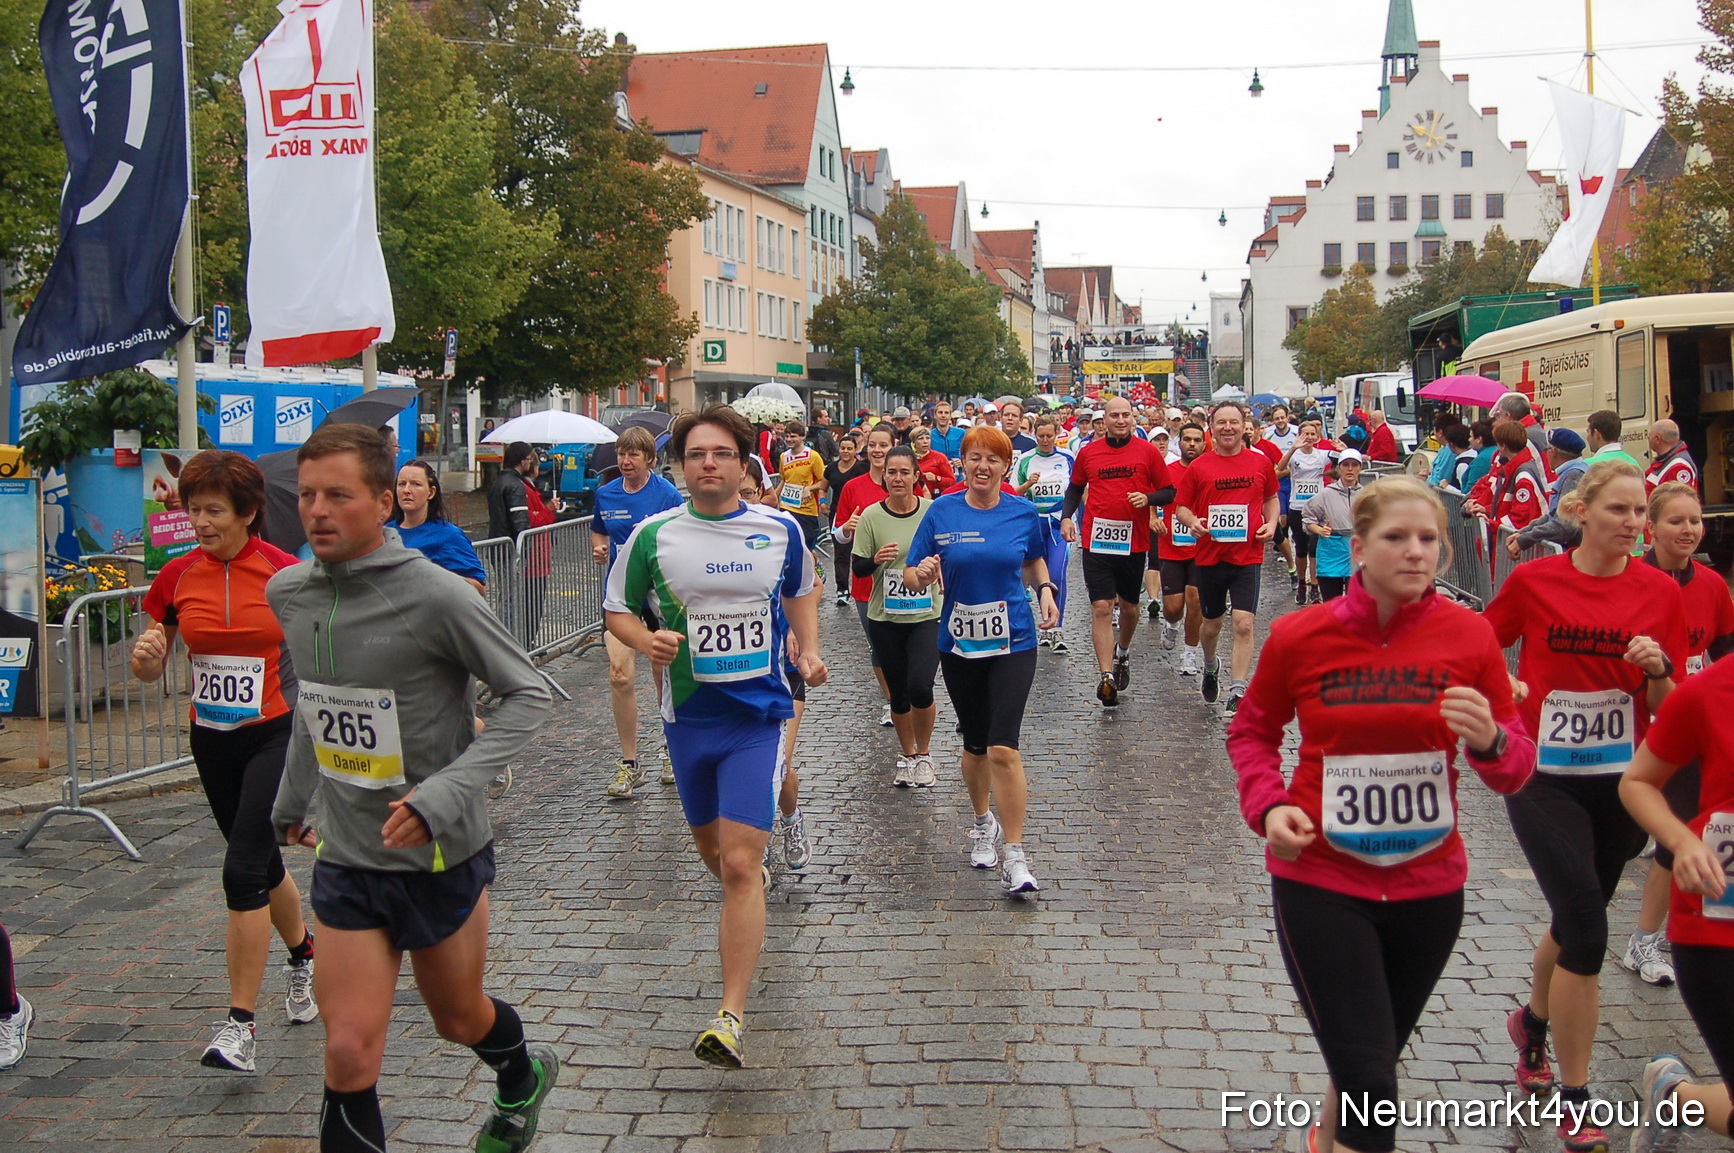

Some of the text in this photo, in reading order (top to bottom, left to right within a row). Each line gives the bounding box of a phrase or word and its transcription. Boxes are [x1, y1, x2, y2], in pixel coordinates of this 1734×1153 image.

[217, 310, 227, 338] P
[707, 343, 722, 360] D
[1112, 363, 1144, 372] START
[1539, 350, 1590, 378] Bayerisches
[1539, 380, 1562, 399] Rotes
[1618, 431, 1644, 444] ayerisches
[783, 488, 800, 499] 2976
[1035, 484, 1061, 496] 2812
[1297, 484, 1319, 494] 2200
[1211, 514, 1243, 528] 2682
[153, 523, 175, 534] BEIDE
[1095, 527, 1128, 541] 2939
[706, 561, 753, 574] Stefan
[689, 610, 758, 621] PARTL Neumarkt
[968, 608, 996, 617] Neumarkt
[953, 615, 1003, 638] 3118
[697, 620, 764, 653] 2813
[1551, 638, 1571, 649] RUN
[1573, 639, 1595, 651] FOR
[194, 661, 249, 672] PARTL Neumarkt
[716, 658, 750, 671] Stefan
[199, 672, 254, 703] 2603
[1325, 686, 1354, 699] RUN
[1357, 684, 1384, 699] FOR
[299, 690, 375, 709] PARTL Neumarkt
[1544, 698, 1616, 709] PARTL Neumarkt
[317, 709, 377, 750] 265
[1549, 709, 1625, 744] 2940
[333, 753, 371, 773] Daniel
[1570, 751, 1603, 764] Petra
[1326, 765, 1427, 778] PARTL Neumarkt
[1336, 781, 1440, 826] 3000
[1359, 837, 1417, 852] Nadine
